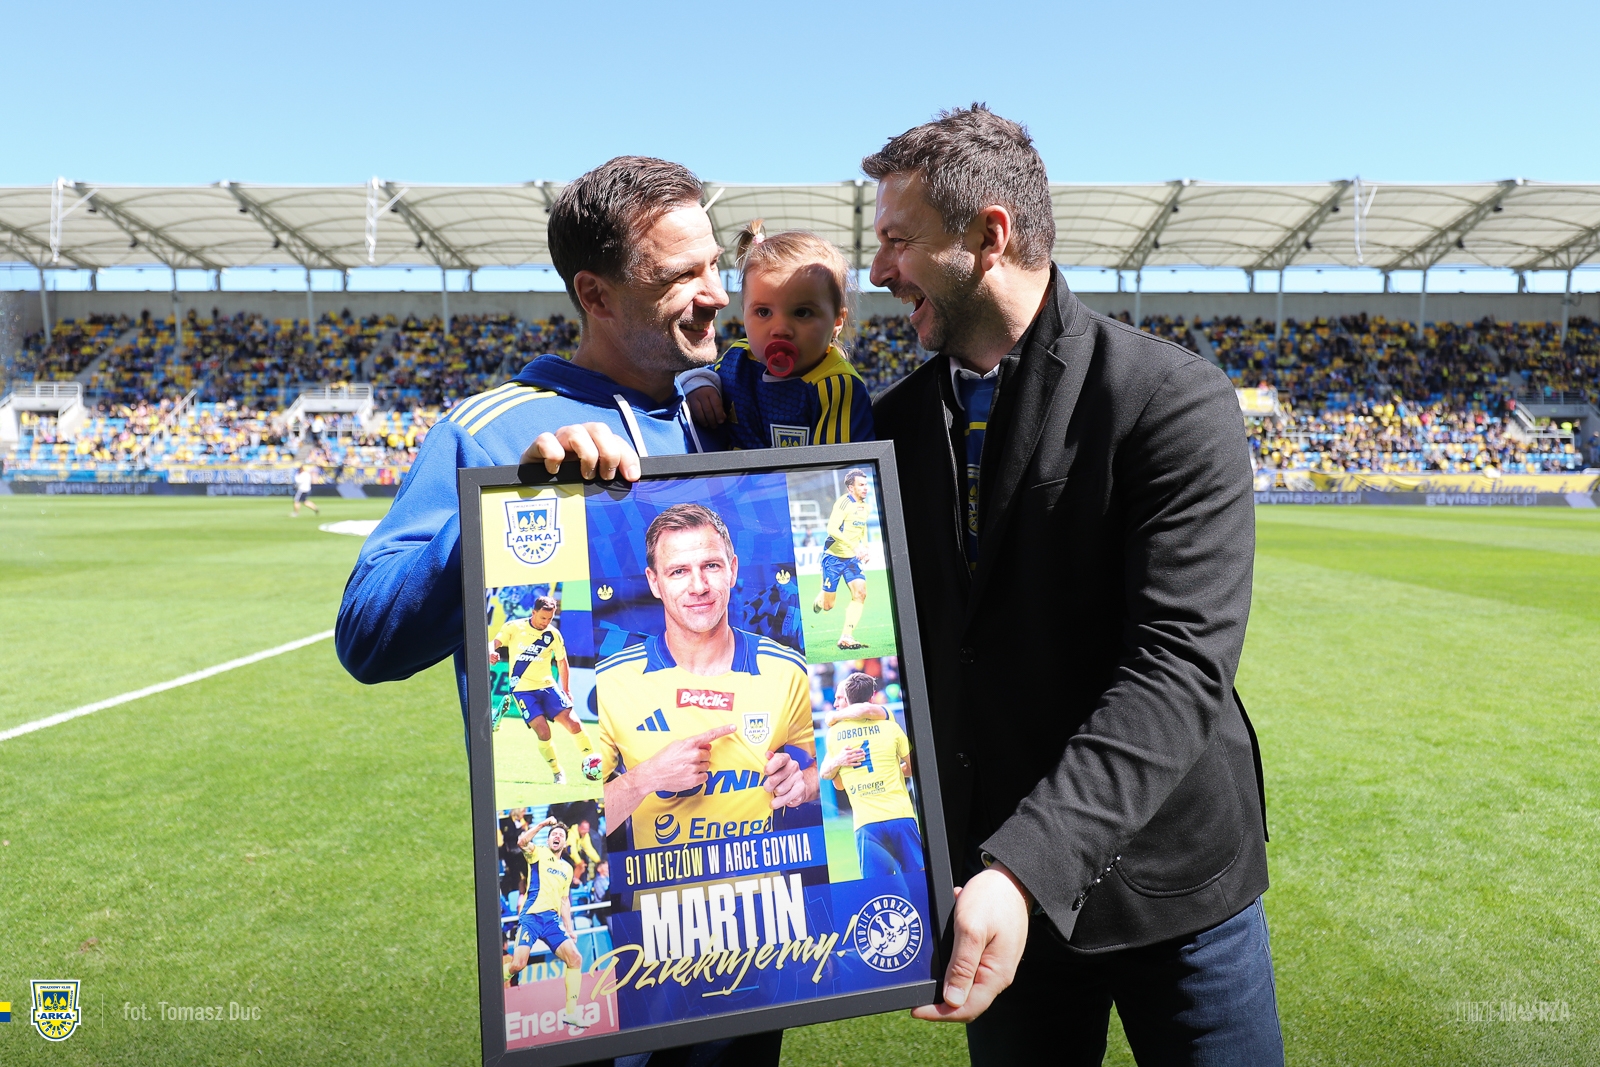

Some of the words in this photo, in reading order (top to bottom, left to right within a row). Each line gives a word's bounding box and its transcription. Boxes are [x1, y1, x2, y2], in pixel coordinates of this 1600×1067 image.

[46, 482, 148, 495] gdyniasport.pl
[207, 483, 294, 496] gdyniasport
[1426, 493, 1537, 506] gdyniasport.pl
[515, 533, 552, 543] ARKA
[824, 577, 832, 589] 4
[680, 692, 729, 708] Betclic
[837, 725, 880, 741] DOBROTKA
[857, 780, 884, 791] Energa
[689, 815, 772, 840] Energa
[625, 855, 642, 886] 91
[645, 843, 703, 883] MECZÓW
[707, 845, 720, 875] W
[725, 839, 757, 873] ARCE
[762, 832, 812, 867] GDYNIA
[640, 873, 808, 964] MARTIN
[857, 911, 872, 950] LUDZIE
[872, 899, 909, 915] MORZA
[521, 931, 531, 943] 4
[872, 955, 900, 968] ARKA
[902, 922, 920, 960] GDYNIA
[590, 914, 858, 1001] Dziękujemy!
[505, 1001, 601, 1042] Energa
